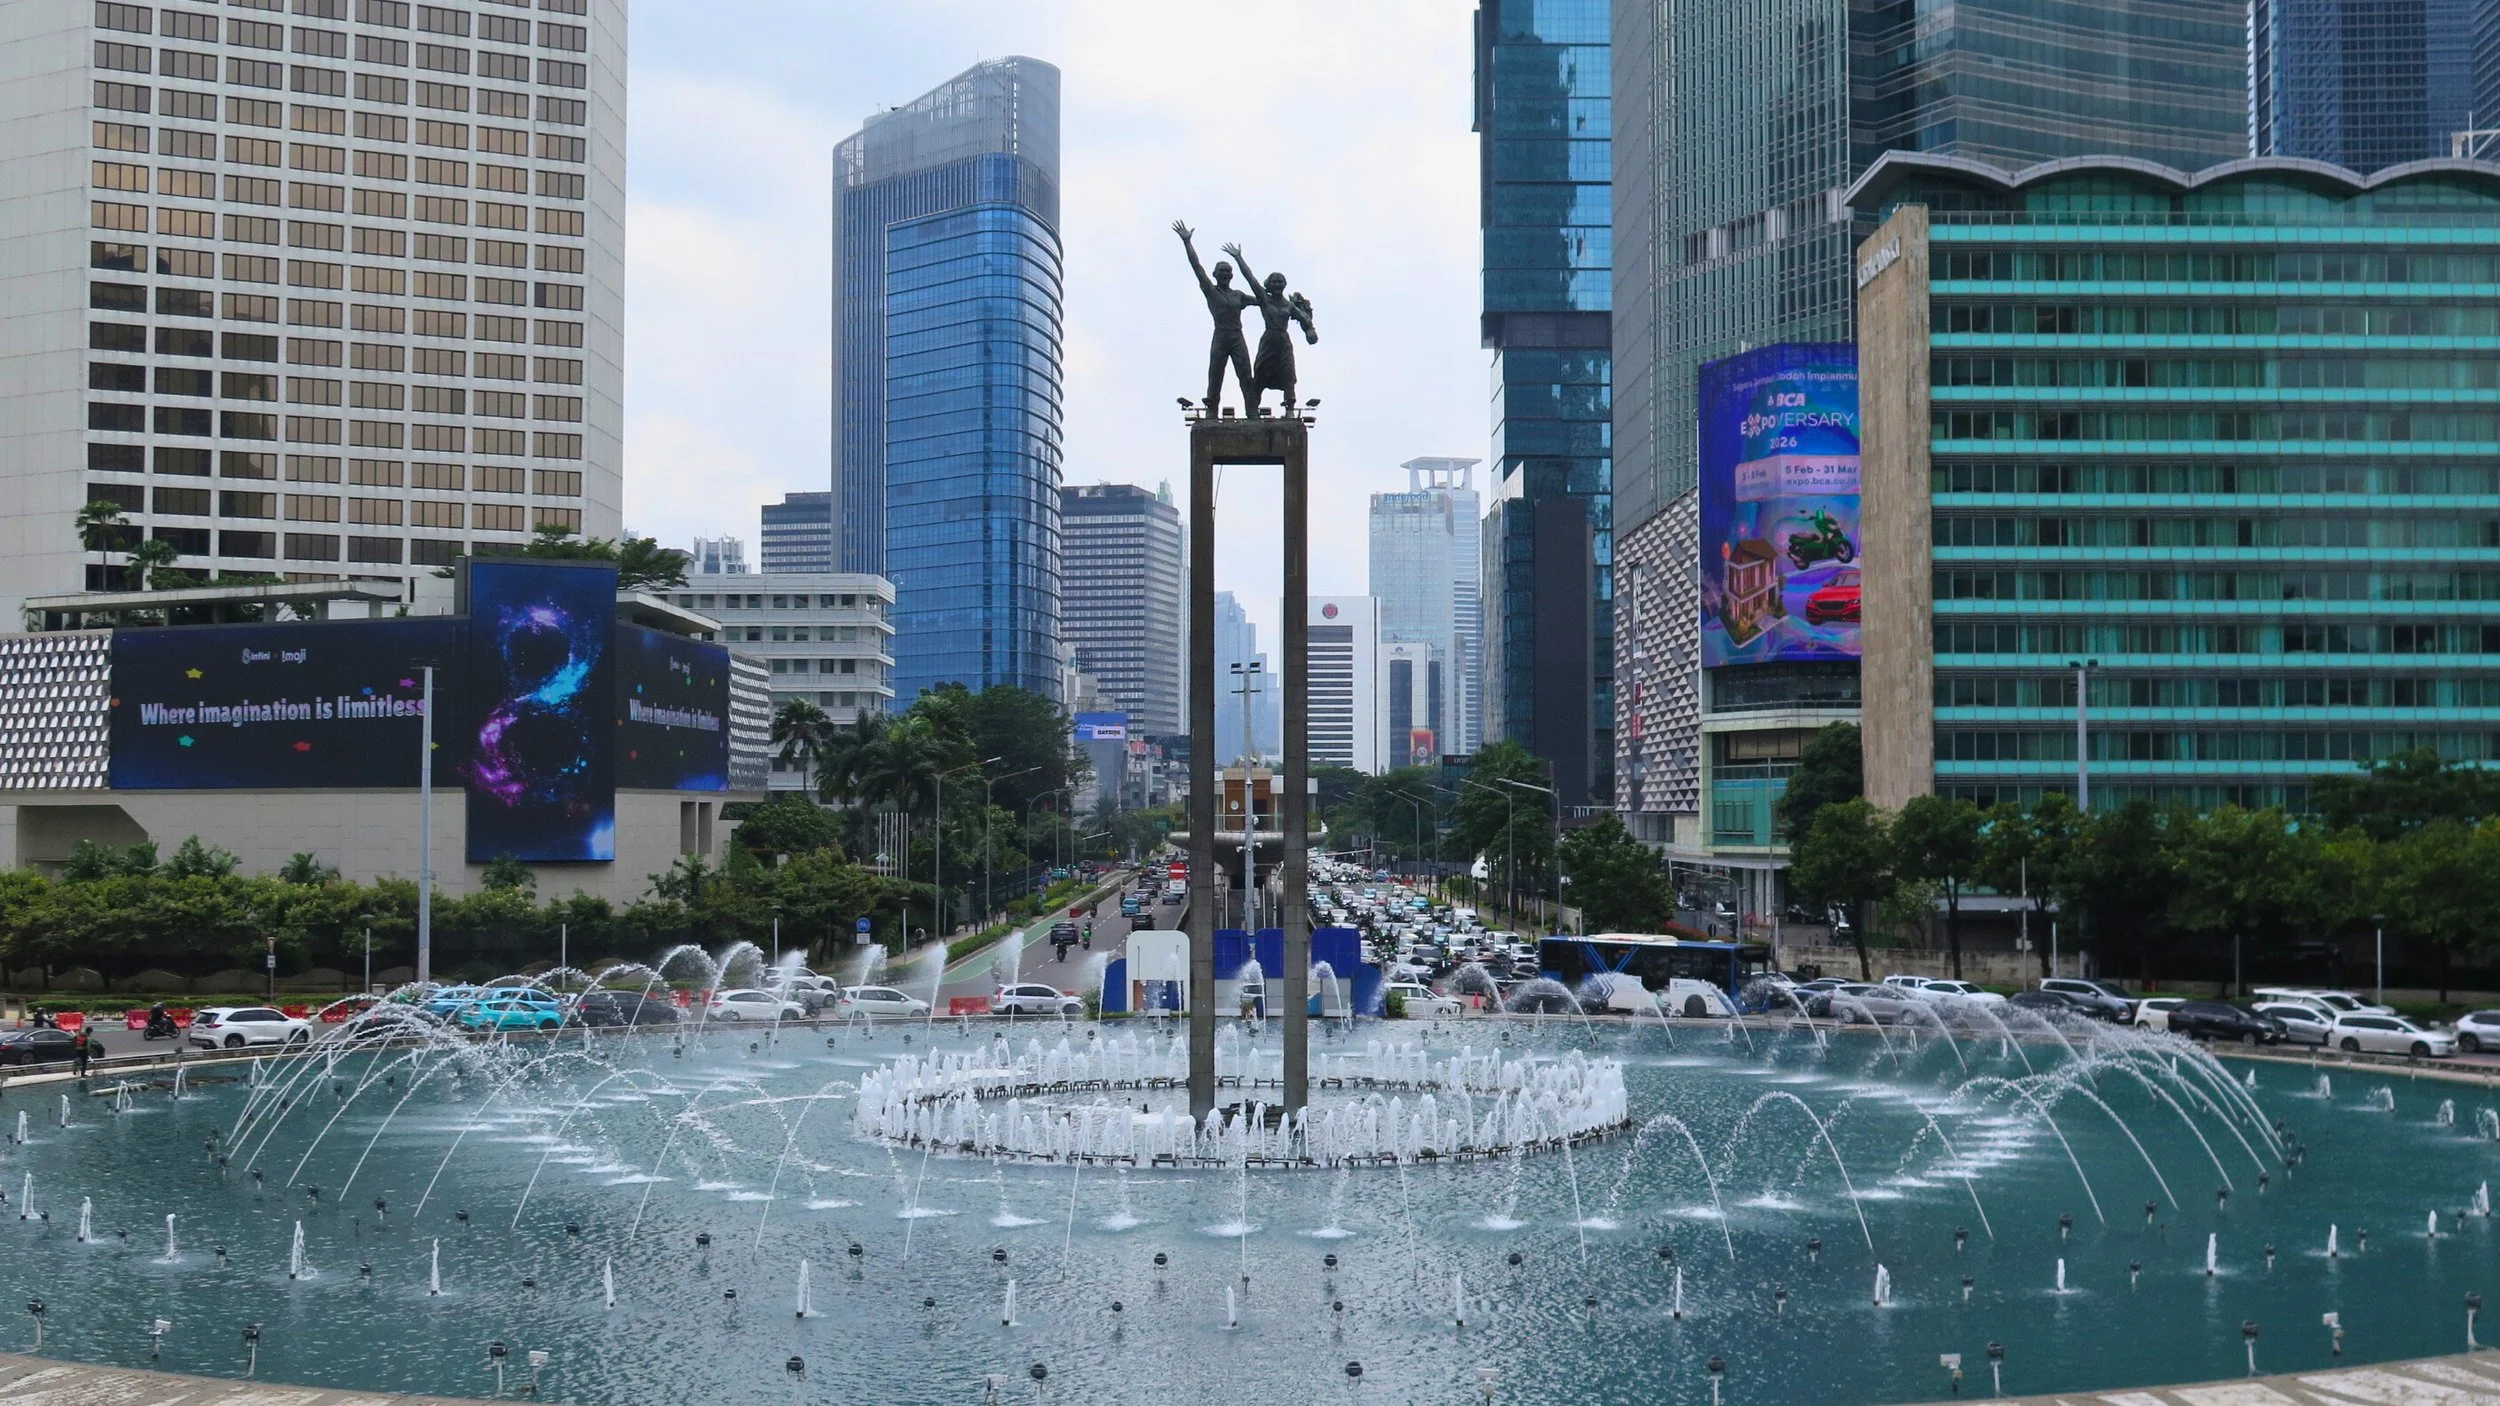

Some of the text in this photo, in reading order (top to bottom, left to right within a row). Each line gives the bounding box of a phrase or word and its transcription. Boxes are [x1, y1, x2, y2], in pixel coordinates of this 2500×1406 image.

[1808, 372, 1858, 382] Impianmu
[1776, 393, 1805, 407] BCA
[1770, 437, 1797, 449] 2026
[1785, 465, 1792, 474] 5
[1794, 465, 1814, 474] Feb
[1824, 465, 1835, 474] 31
[1837, 465, 1857, 474] Mar
[140, 694, 425, 728] Where imagination is limitless
